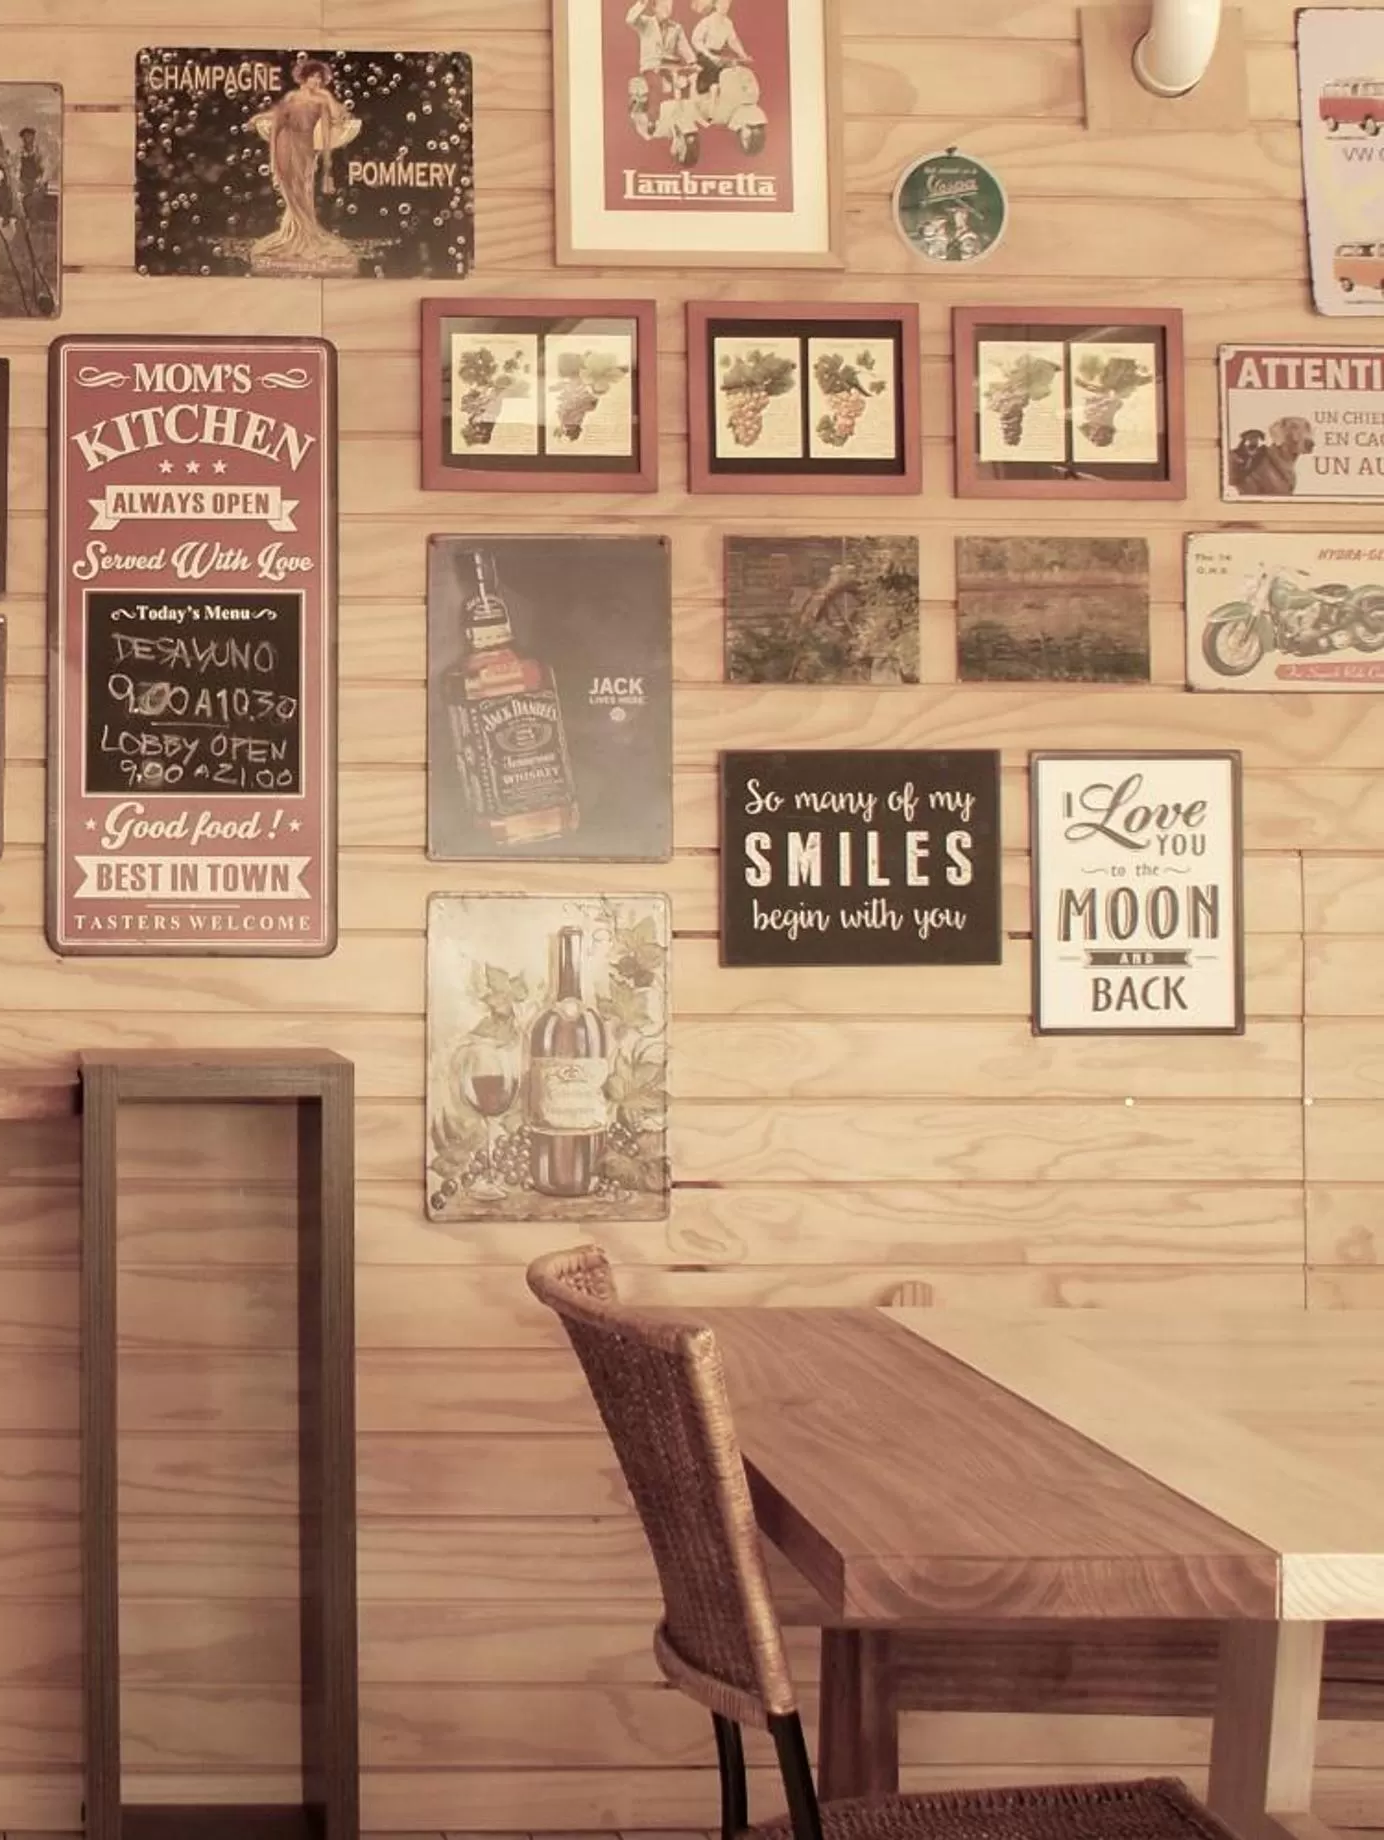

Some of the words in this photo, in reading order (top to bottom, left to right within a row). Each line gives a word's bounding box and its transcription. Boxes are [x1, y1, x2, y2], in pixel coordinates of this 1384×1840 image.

[148, 65, 282, 92] CHAMPAGNE
[348, 161, 457, 188] POMMERY
[622, 169, 777, 200] Lambretta
[132, 362, 253, 394] MOM'S
[1237, 356, 1383, 389] ATTENTI
[1314, 411, 1338, 425] UN
[1343, 411, 1384, 425] CHIE
[71, 403, 317, 472] KITCHEN
[1324, 431, 1349, 447] EN
[1314, 456, 1350, 476] UN
[111, 492, 205, 514] ALWAYS
[212, 492, 270, 515] OPEN
[71, 540, 166, 581] Served
[171, 541, 252, 580] With
[257, 541, 315, 582] Love
[136, 605, 201, 624] Today's
[204, 605, 251, 621] Menu
[111, 632, 275, 673] DESAYUNO
[587, 676, 645, 696] JACK
[101, 724, 200, 766] LOBBY
[210, 731, 287, 763] OPEN
[744, 777, 785, 815] So
[794, 789, 878, 823] many
[887, 781, 920, 822] of
[929, 789, 976, 822] my
[1063, 791, 1073, 818] I
[1064, 773, 1209, 850] Love
[101, 801, 189, 850] Good
[744, 829, 973, 888] SMILES
[1155, 833, 1207, 856] YOU
[96, 862, 163, 893] BEST
[171, 862, 199, 893] IN
[208, 862, 290, 893] TOWN
[1111, 864, 1127, 878] to
[1135, 863, 1160, 878] the
[74, 914, 181, 930] TASTERS
[189, 915, 311, 931] WELCOME
[752, 898, 831, 941] begin
[839, 897, 904, 931] with
[913, 907, 968, 941] you
[1057, 884, 1219, 942] MOON
[1119, 953, 1154, 965] AND
[1091, 975, 1189, 1013] BACK
